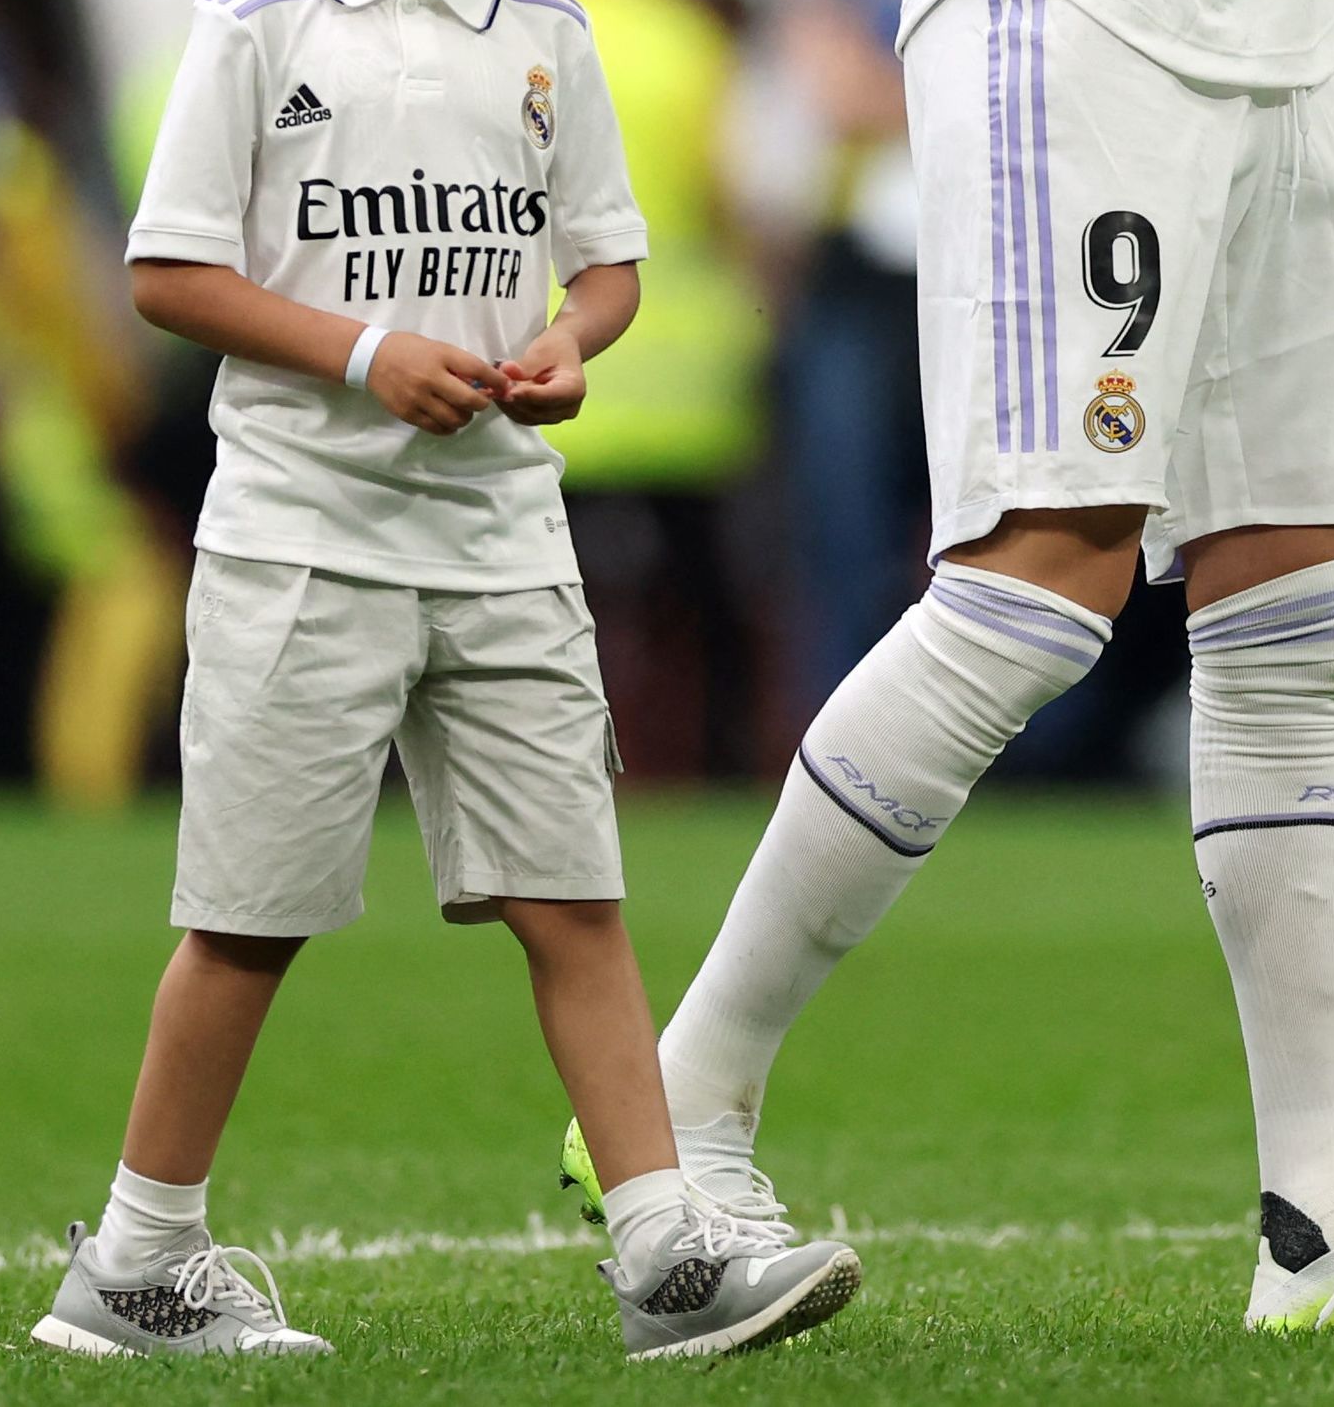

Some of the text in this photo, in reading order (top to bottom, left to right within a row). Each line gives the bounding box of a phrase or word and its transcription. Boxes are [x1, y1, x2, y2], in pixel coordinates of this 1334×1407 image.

[275, 107, 332, 129] adidas
[295, 167, 549, 241] Emirates
[343, 246, 522, 302] FLY BETTER
[1081, 210, 1162, 358] 9
